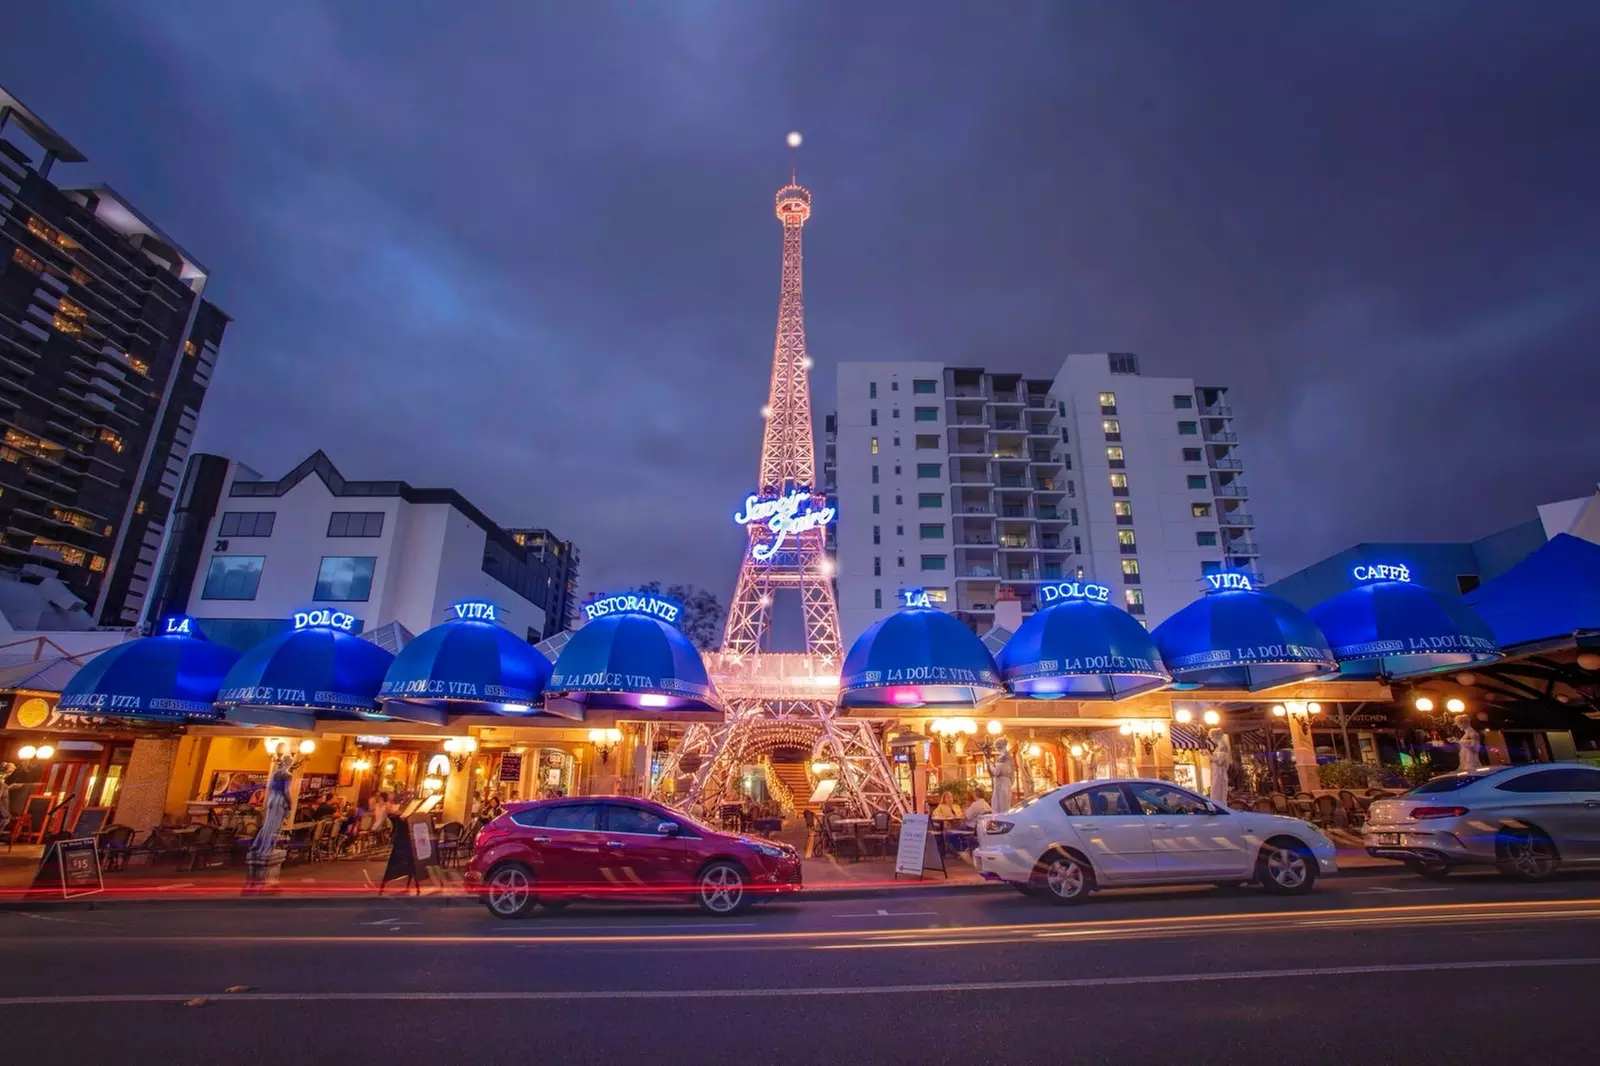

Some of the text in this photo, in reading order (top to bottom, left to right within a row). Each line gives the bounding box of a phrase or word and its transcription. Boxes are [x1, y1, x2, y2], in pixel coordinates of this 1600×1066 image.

[1354, 564, 1410, 582] CAFFÈ
[1208, 573, 1252, 590] VITA
[1042, 583, 1109, 601] DOLCE
[905, 592, 932, 608] LA
[455, 603, 496, 620] VITA
[585, 596, 679, 622] RISTORANTE
[167, 618, 190, 633] LA
[294, 610, 355, 630] DOLCE
[1409, 637, 1430, 649] LA
[1430, 635, 1475, 648] DOLCE
[1237, 648, 1256, 659] LA
[1257, 645, 1301, 657] DOLCE
[1065, 656, 1152, 670] LA DOLCE VITA
[566, 672, 653, 688] LA DOLCE VITA
[887, 667, 977, 681] LA DOLCE VITA
[224, 686, 306, 701] LA DOLCE VITA
[392, 680, 477, 695] LA DOLCE VITA
[111, 695, 140, 707] VITA
